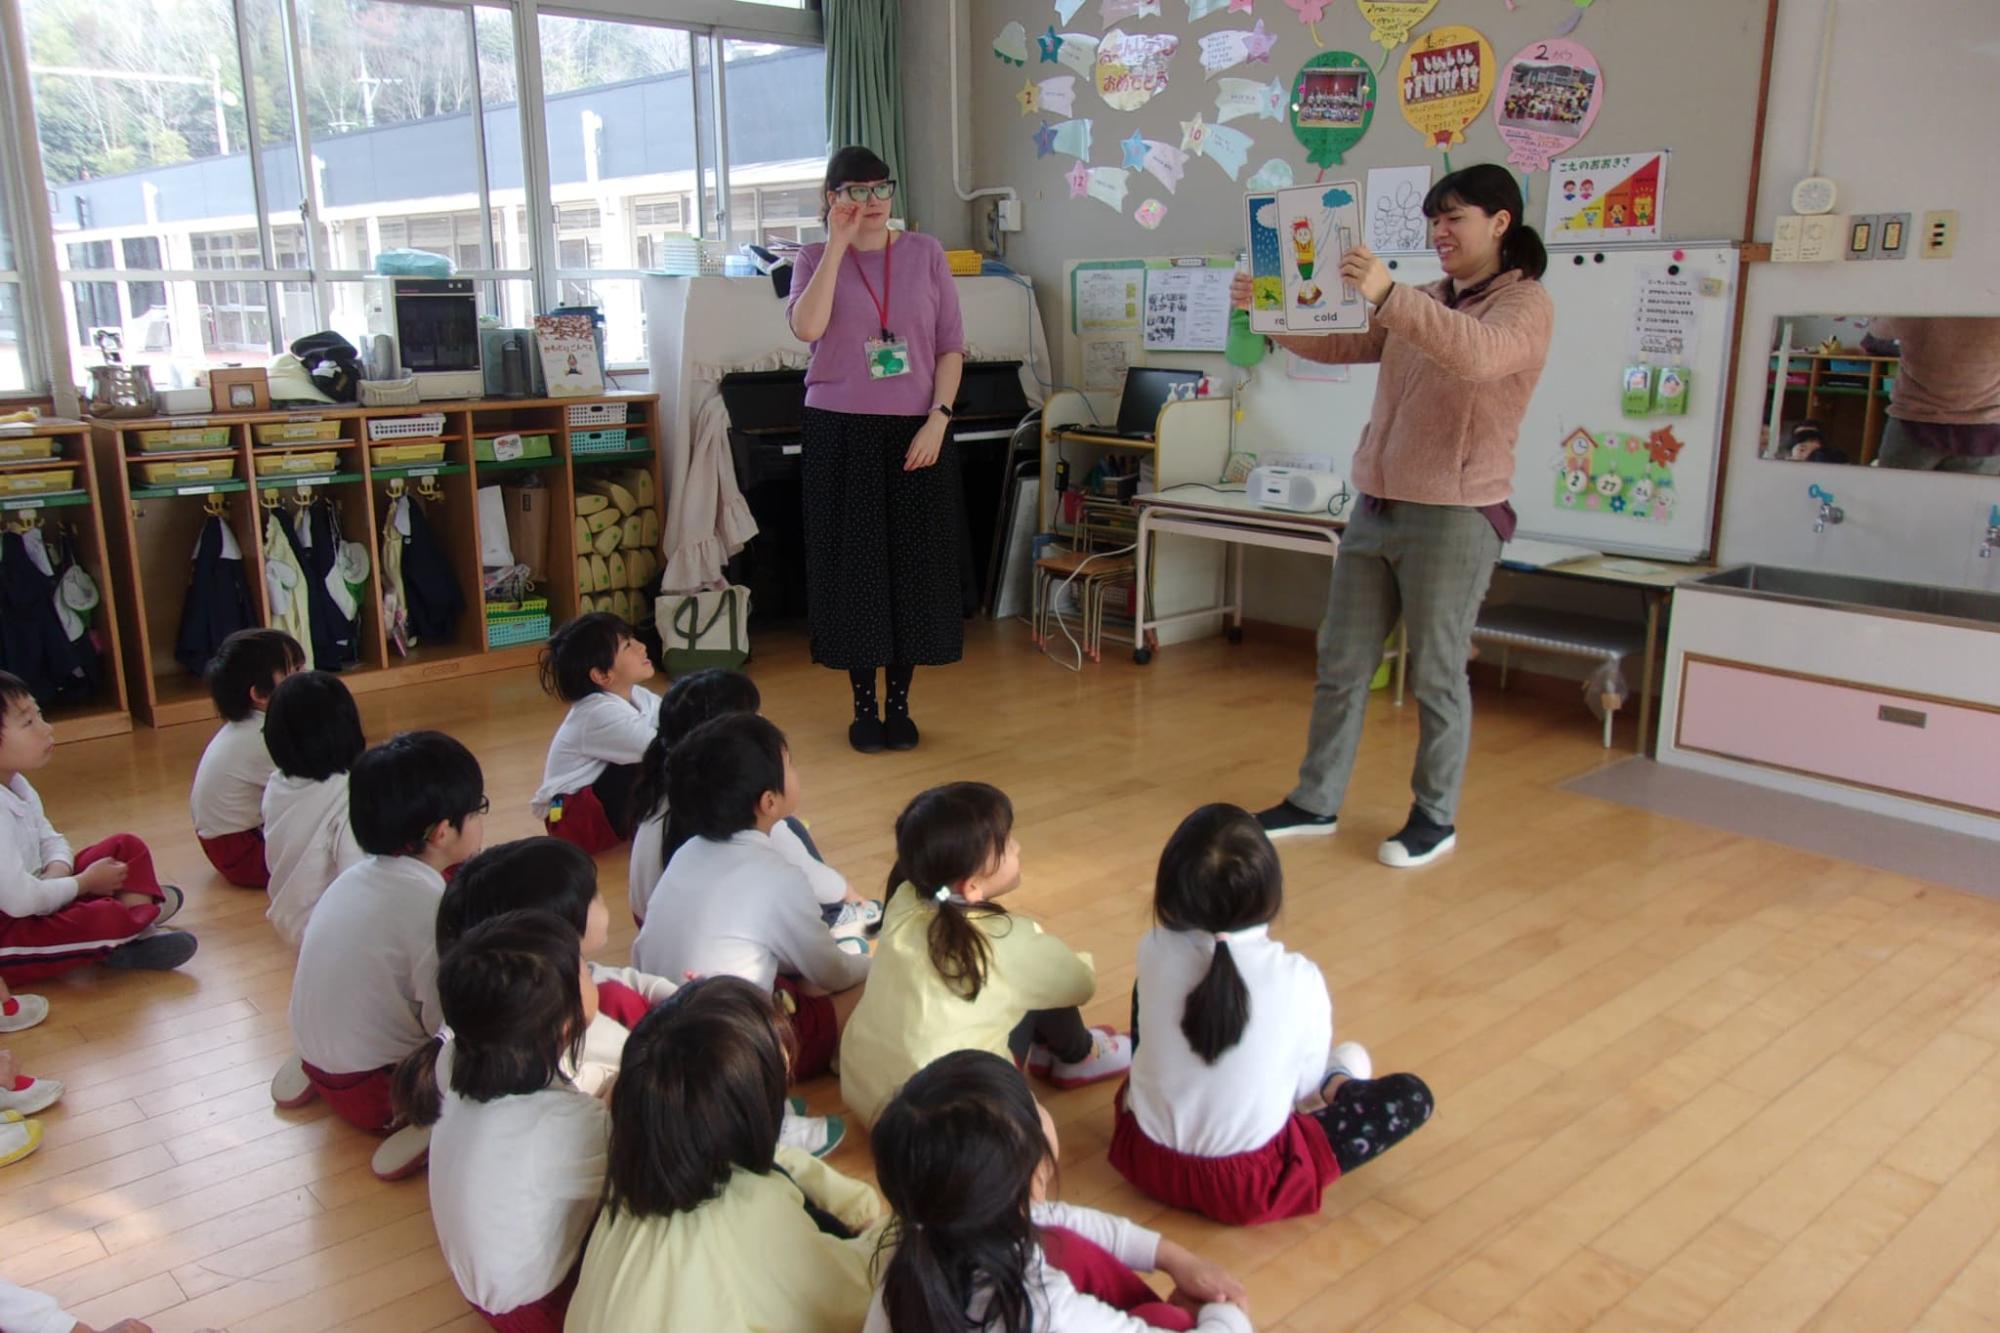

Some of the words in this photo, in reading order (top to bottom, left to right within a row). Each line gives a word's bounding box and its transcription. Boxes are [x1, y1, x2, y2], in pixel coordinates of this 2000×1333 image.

[1559, 155, 1631, 172] こえのおおきさ
[1313, 312, 1338, 322] cold
[1600, 480, 1617, 493] 27
